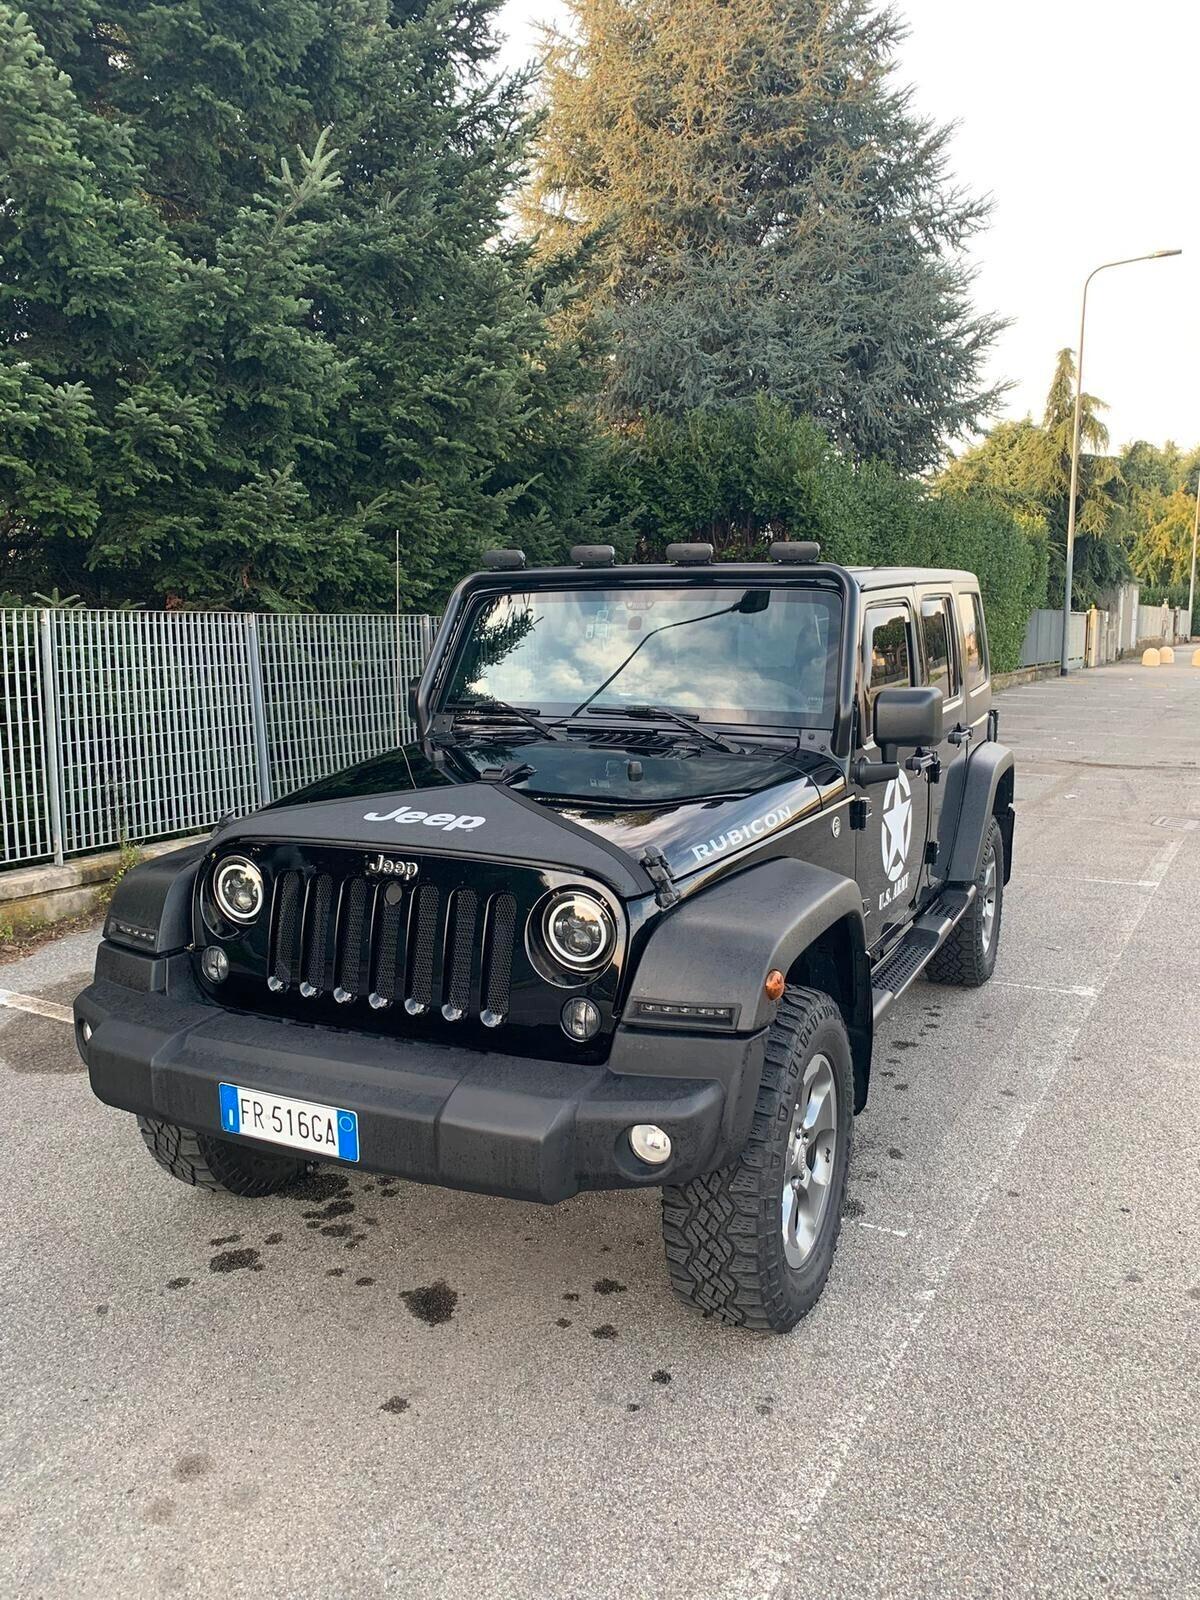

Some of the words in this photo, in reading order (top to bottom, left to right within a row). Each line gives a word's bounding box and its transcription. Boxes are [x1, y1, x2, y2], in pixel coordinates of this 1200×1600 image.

[363, 806, 486, 831] Jeep
[691, 806, 792, 862] RUBICON
[368, 854, 419, 881] Jeep
[879, 887, 892, 911] U.S.
[892, 871, 910, 900] ARMY
[240, 1098, 265, 1129] FR
[271, 1106, 336, 1146] 516GA
